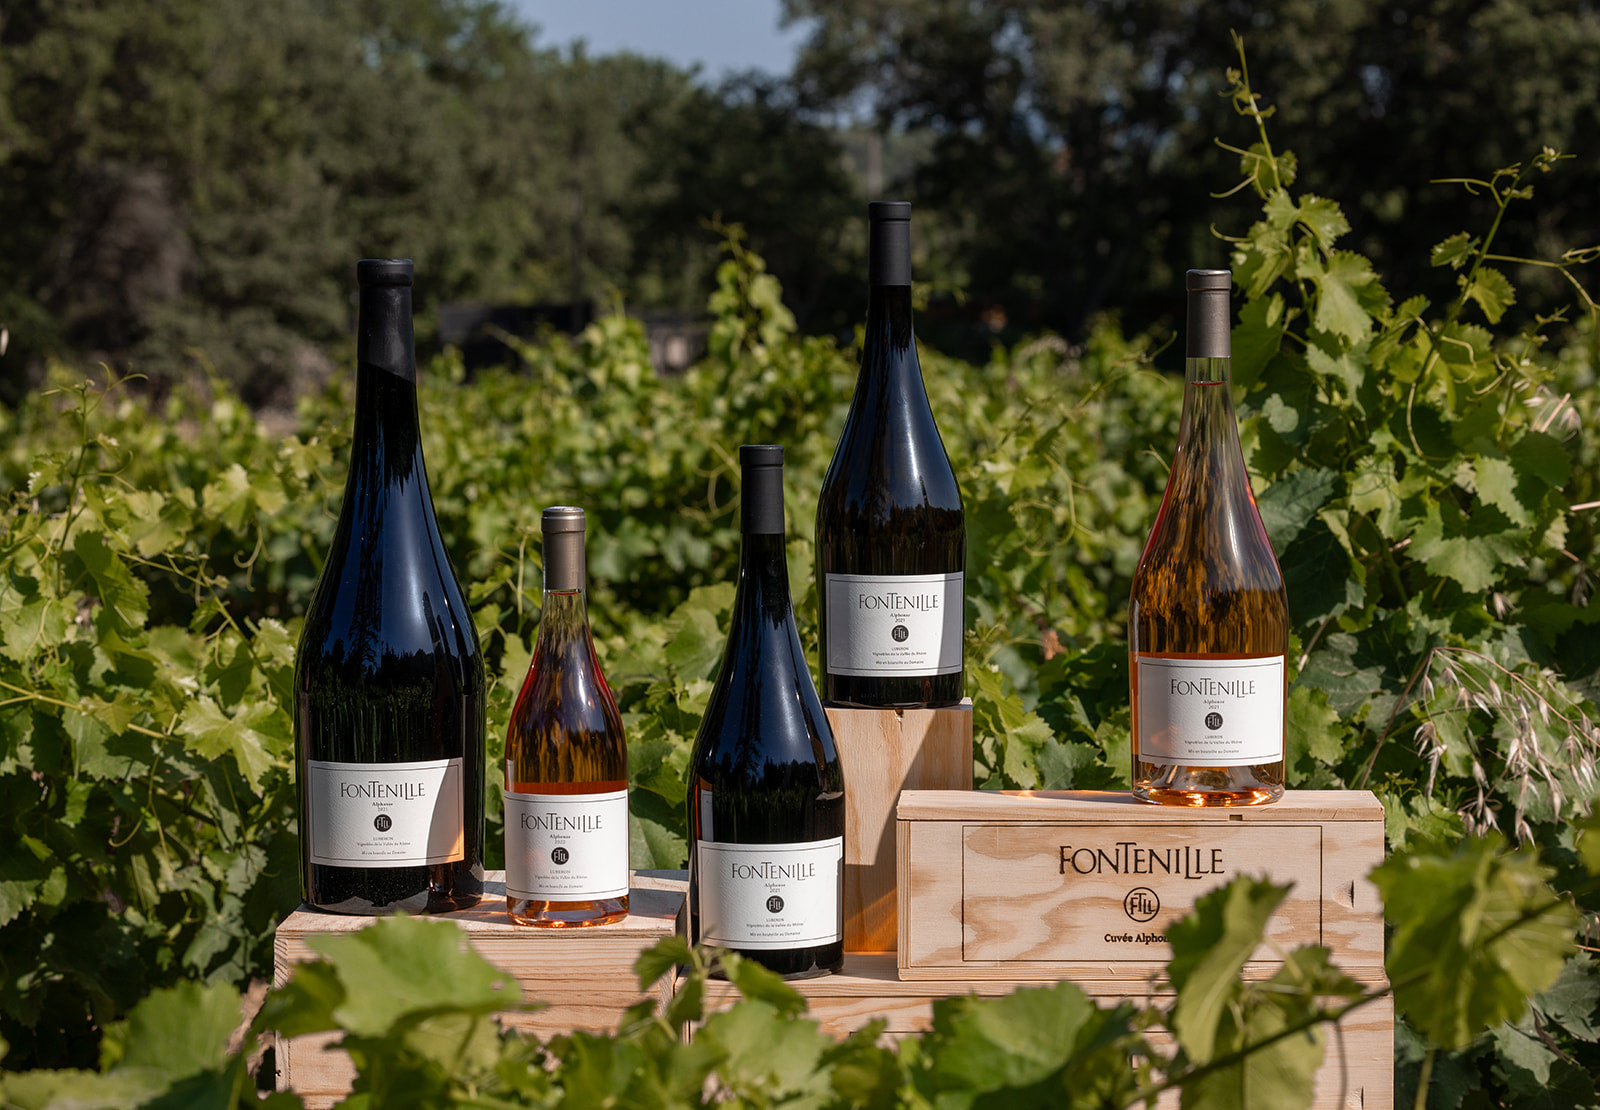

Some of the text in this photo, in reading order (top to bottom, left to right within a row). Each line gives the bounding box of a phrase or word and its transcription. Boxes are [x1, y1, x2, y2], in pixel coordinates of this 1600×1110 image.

[860, 593, 939, 611] FONTENILLE
[1171, 677, 1255, 698] FONTENILLE
[341, 781, 426, 800] FONTENILLE
[521, 812, 603, 832] FONTENILLE
[1059, 842, 1225, 880] FONTENILLE
[732, 862, 815, 881] FONTENILLE
[1104, 932, 1133, 943] Cuvée
